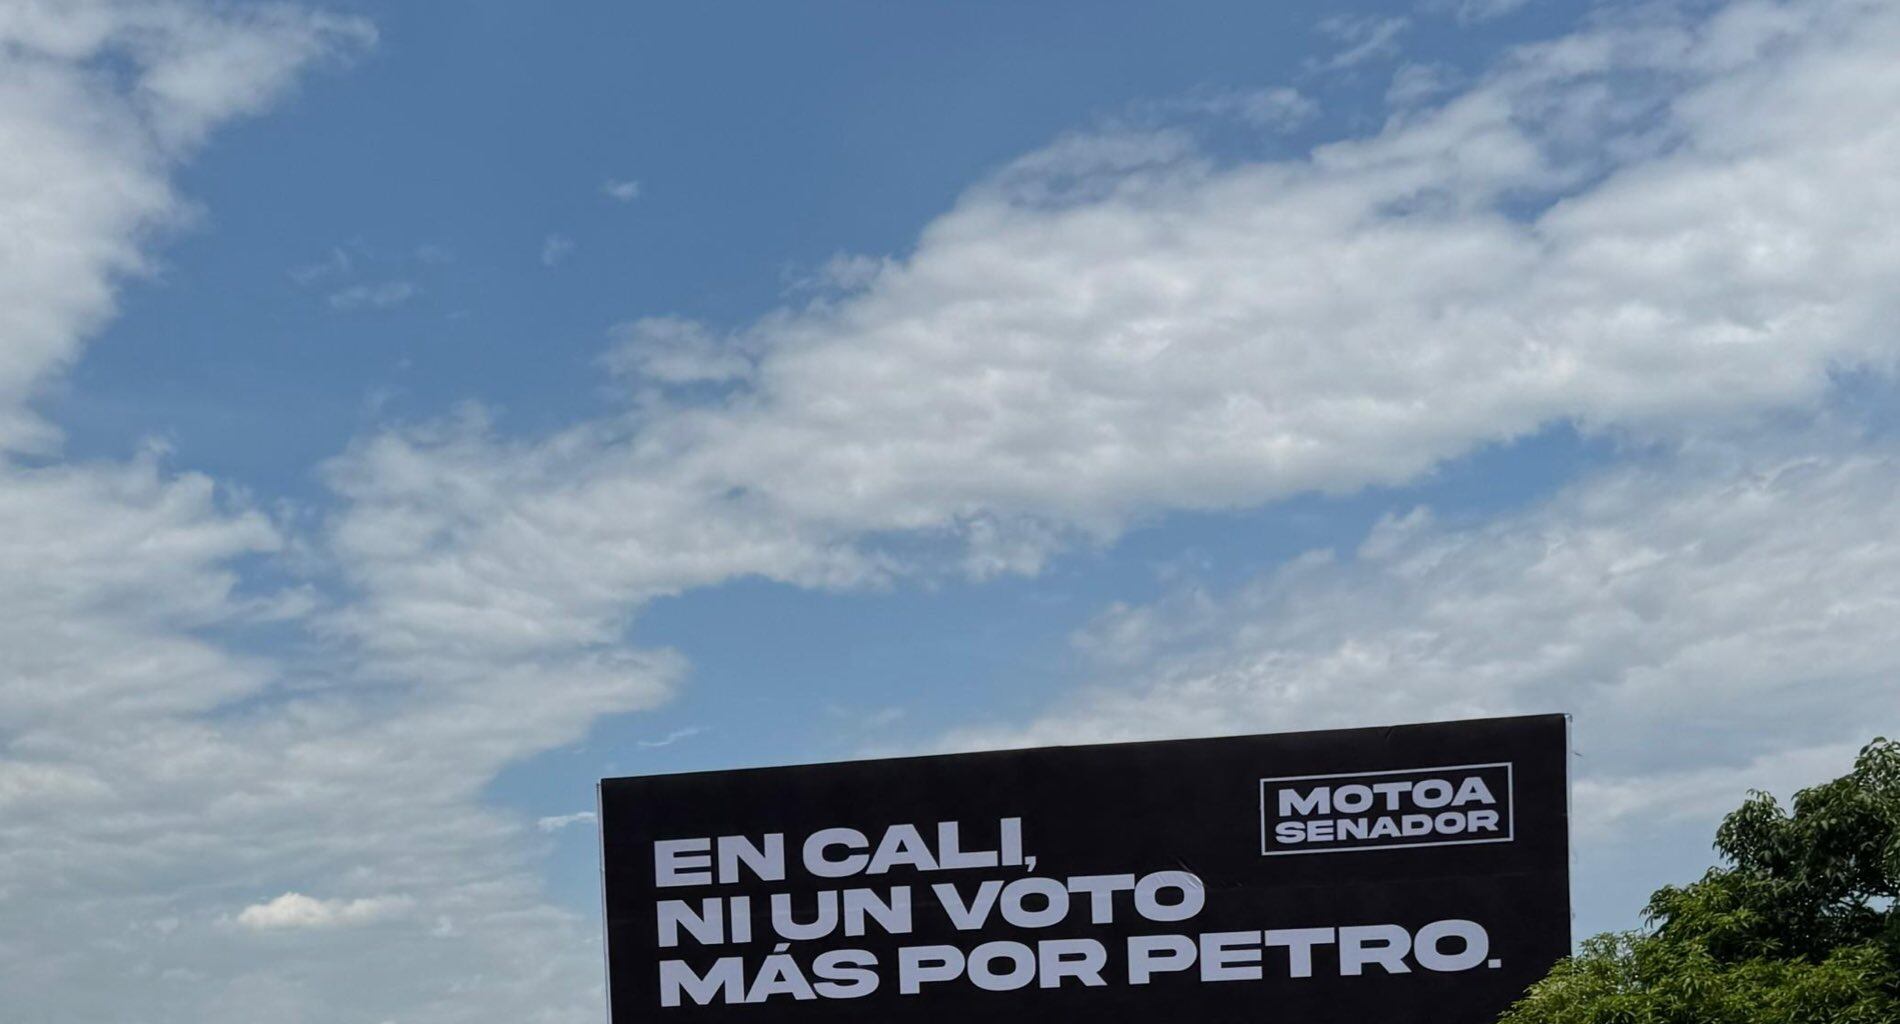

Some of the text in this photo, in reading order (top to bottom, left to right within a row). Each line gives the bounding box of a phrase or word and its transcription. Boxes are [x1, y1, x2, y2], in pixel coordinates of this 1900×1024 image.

[1275, 809, 1499, 844] SENADOR
[1278, 776, 1496, 817] MOTOA
[654, 816, 1037, 888] EN CALI,
[656, 870, 1206, 948] NI UN VOTO
[659, 919, 1502, 1008] MÁS POR PETRO.
